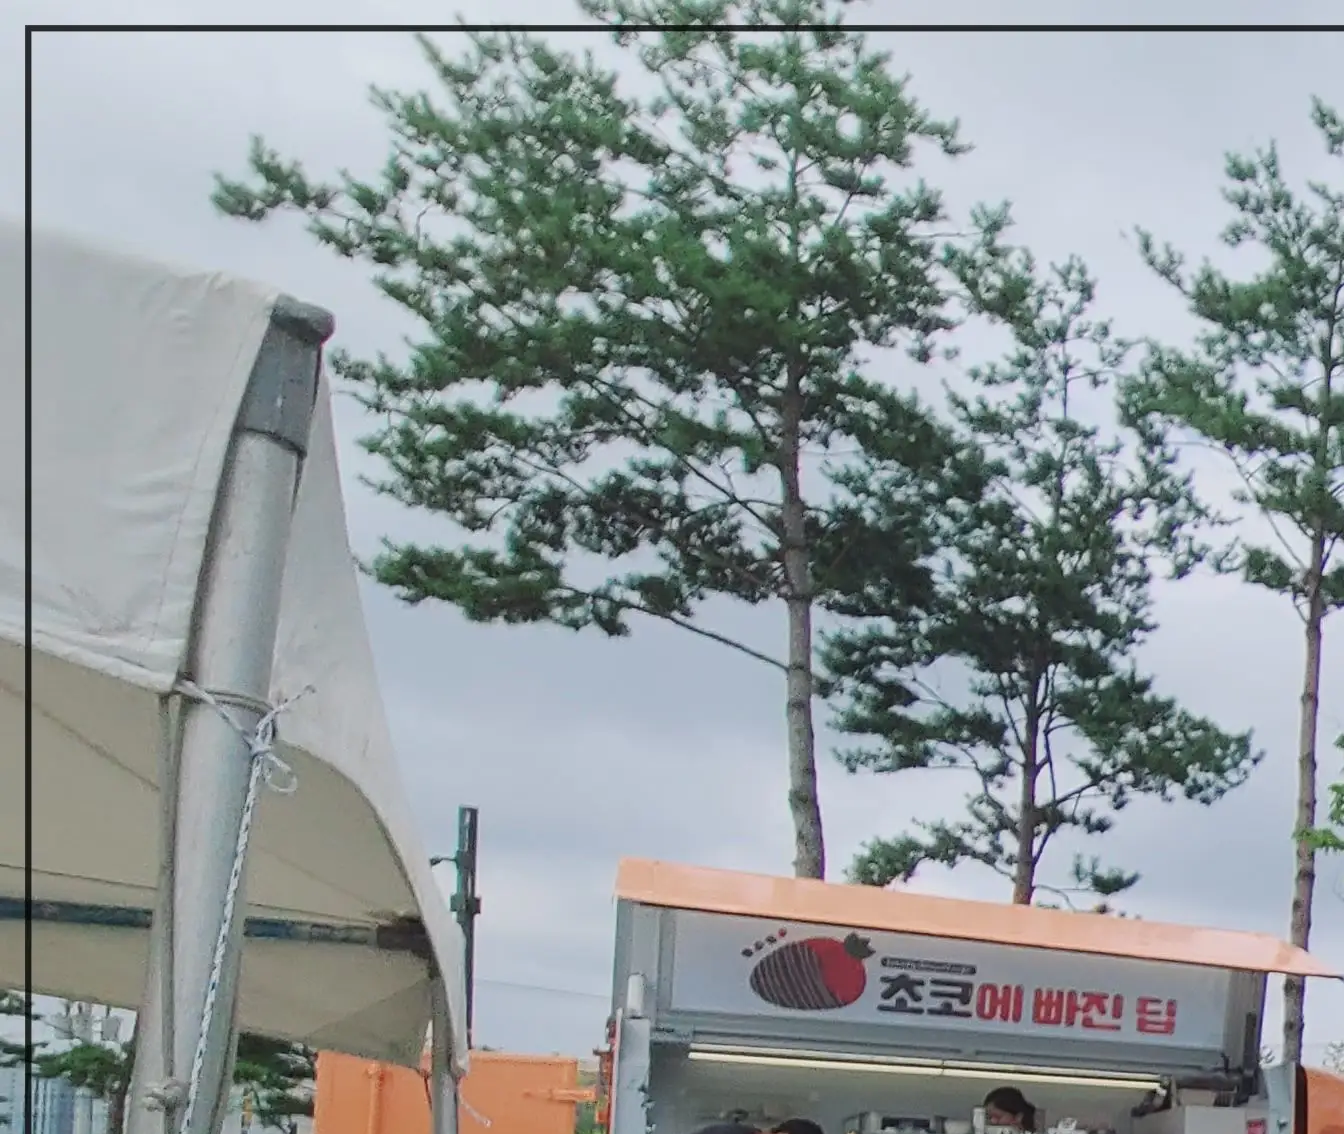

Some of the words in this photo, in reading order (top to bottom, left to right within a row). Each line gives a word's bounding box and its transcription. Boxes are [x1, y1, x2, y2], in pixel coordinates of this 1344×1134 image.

[876, 973, 1025, 1023] 초코에
[1031, 987, 1124, 1031] 빠진
[1135, 995, 1178, 1036] 딥
